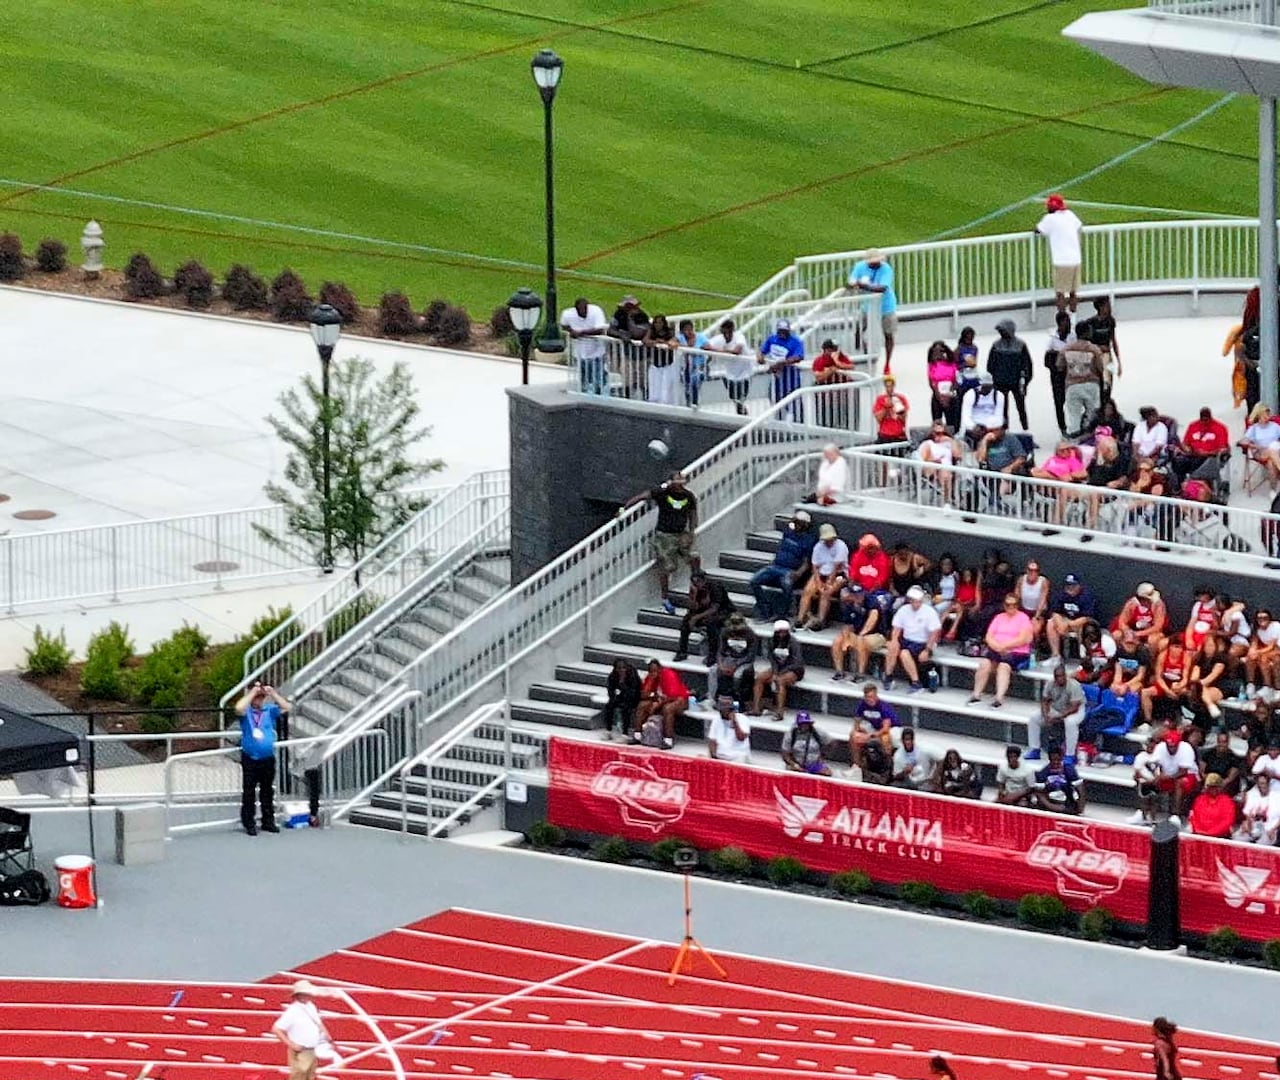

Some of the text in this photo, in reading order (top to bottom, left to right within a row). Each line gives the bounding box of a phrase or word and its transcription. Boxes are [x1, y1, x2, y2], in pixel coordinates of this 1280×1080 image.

[594, 773, 687, 803] GHSA
[831, 805, 944, 850] ATLANTA
[832, 833, 943, 864] TRACK CLUB
[1031, 844, 1128, 877] GHSA
[60, 873, 73, 889] G
